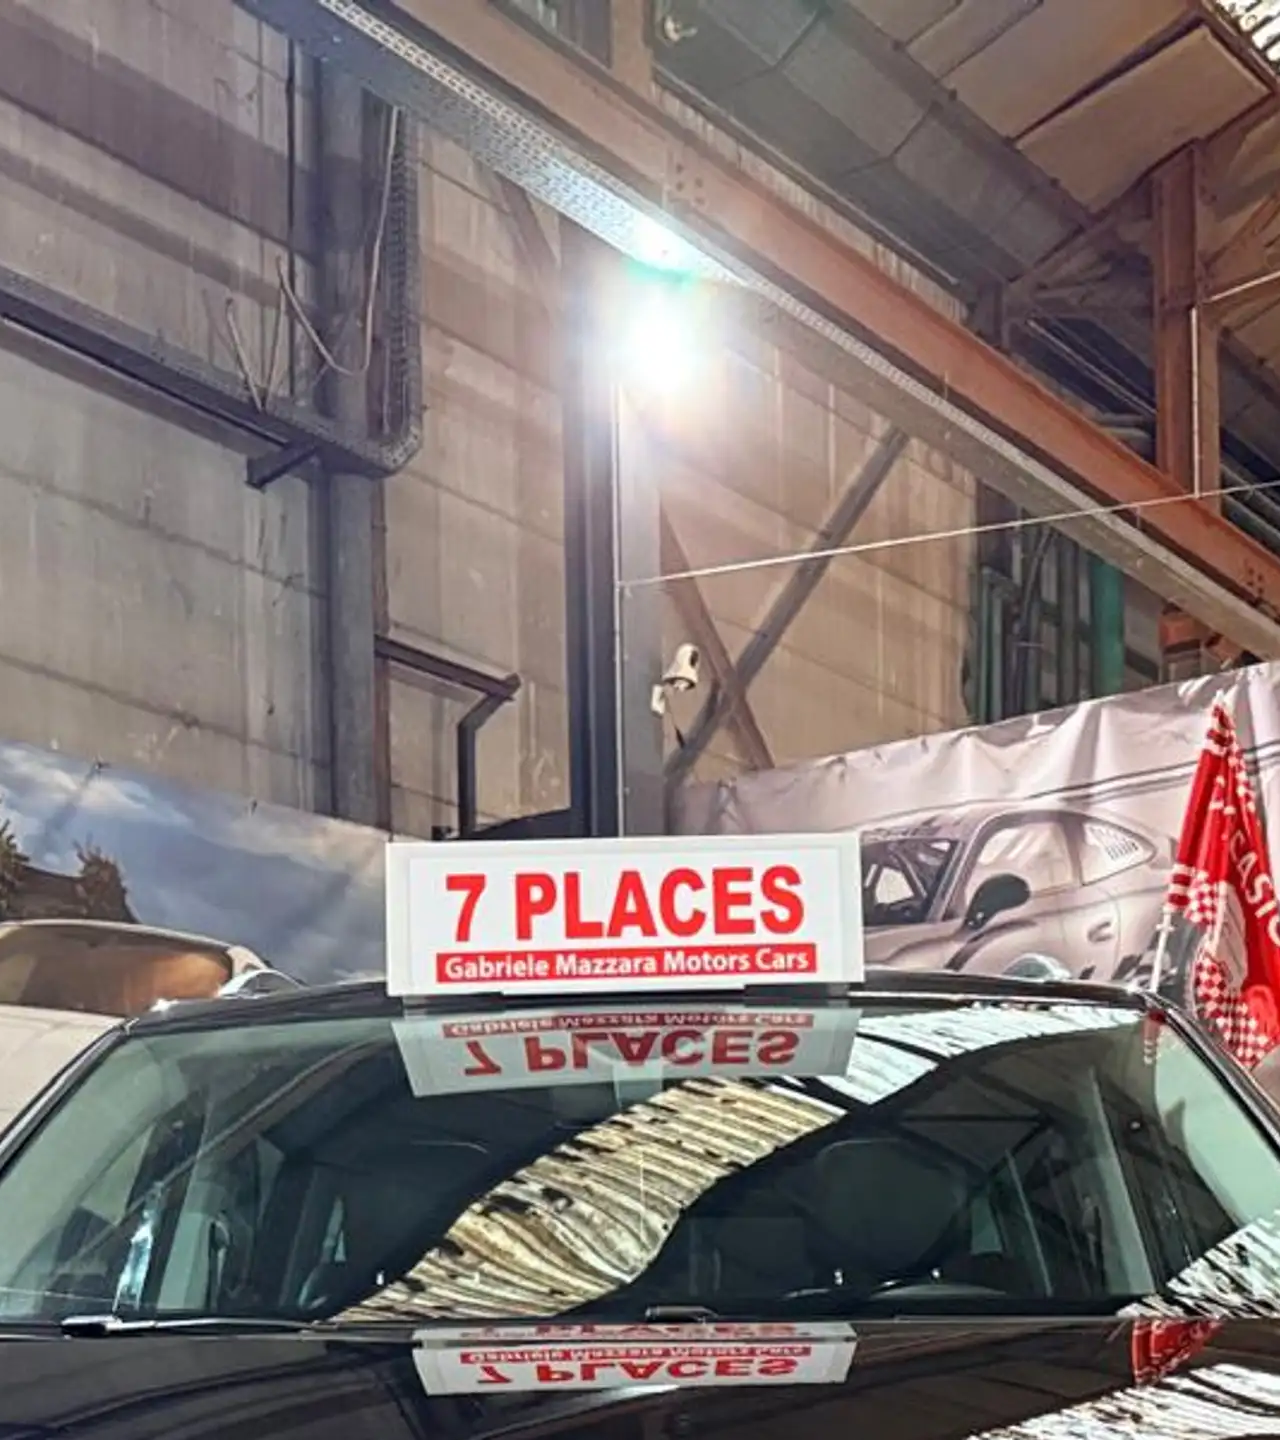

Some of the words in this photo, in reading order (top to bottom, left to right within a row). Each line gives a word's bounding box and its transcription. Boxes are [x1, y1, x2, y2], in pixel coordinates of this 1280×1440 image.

[446, 873, 486, 942] 7
[515, 865, 805, 941] PLACES
[444, 955, 549, 980] Gabriele
[556, 952, 657, 977] Mazzara
[664, 949, 750, 974] Motors
[756, 947, 809, 972] Cars
